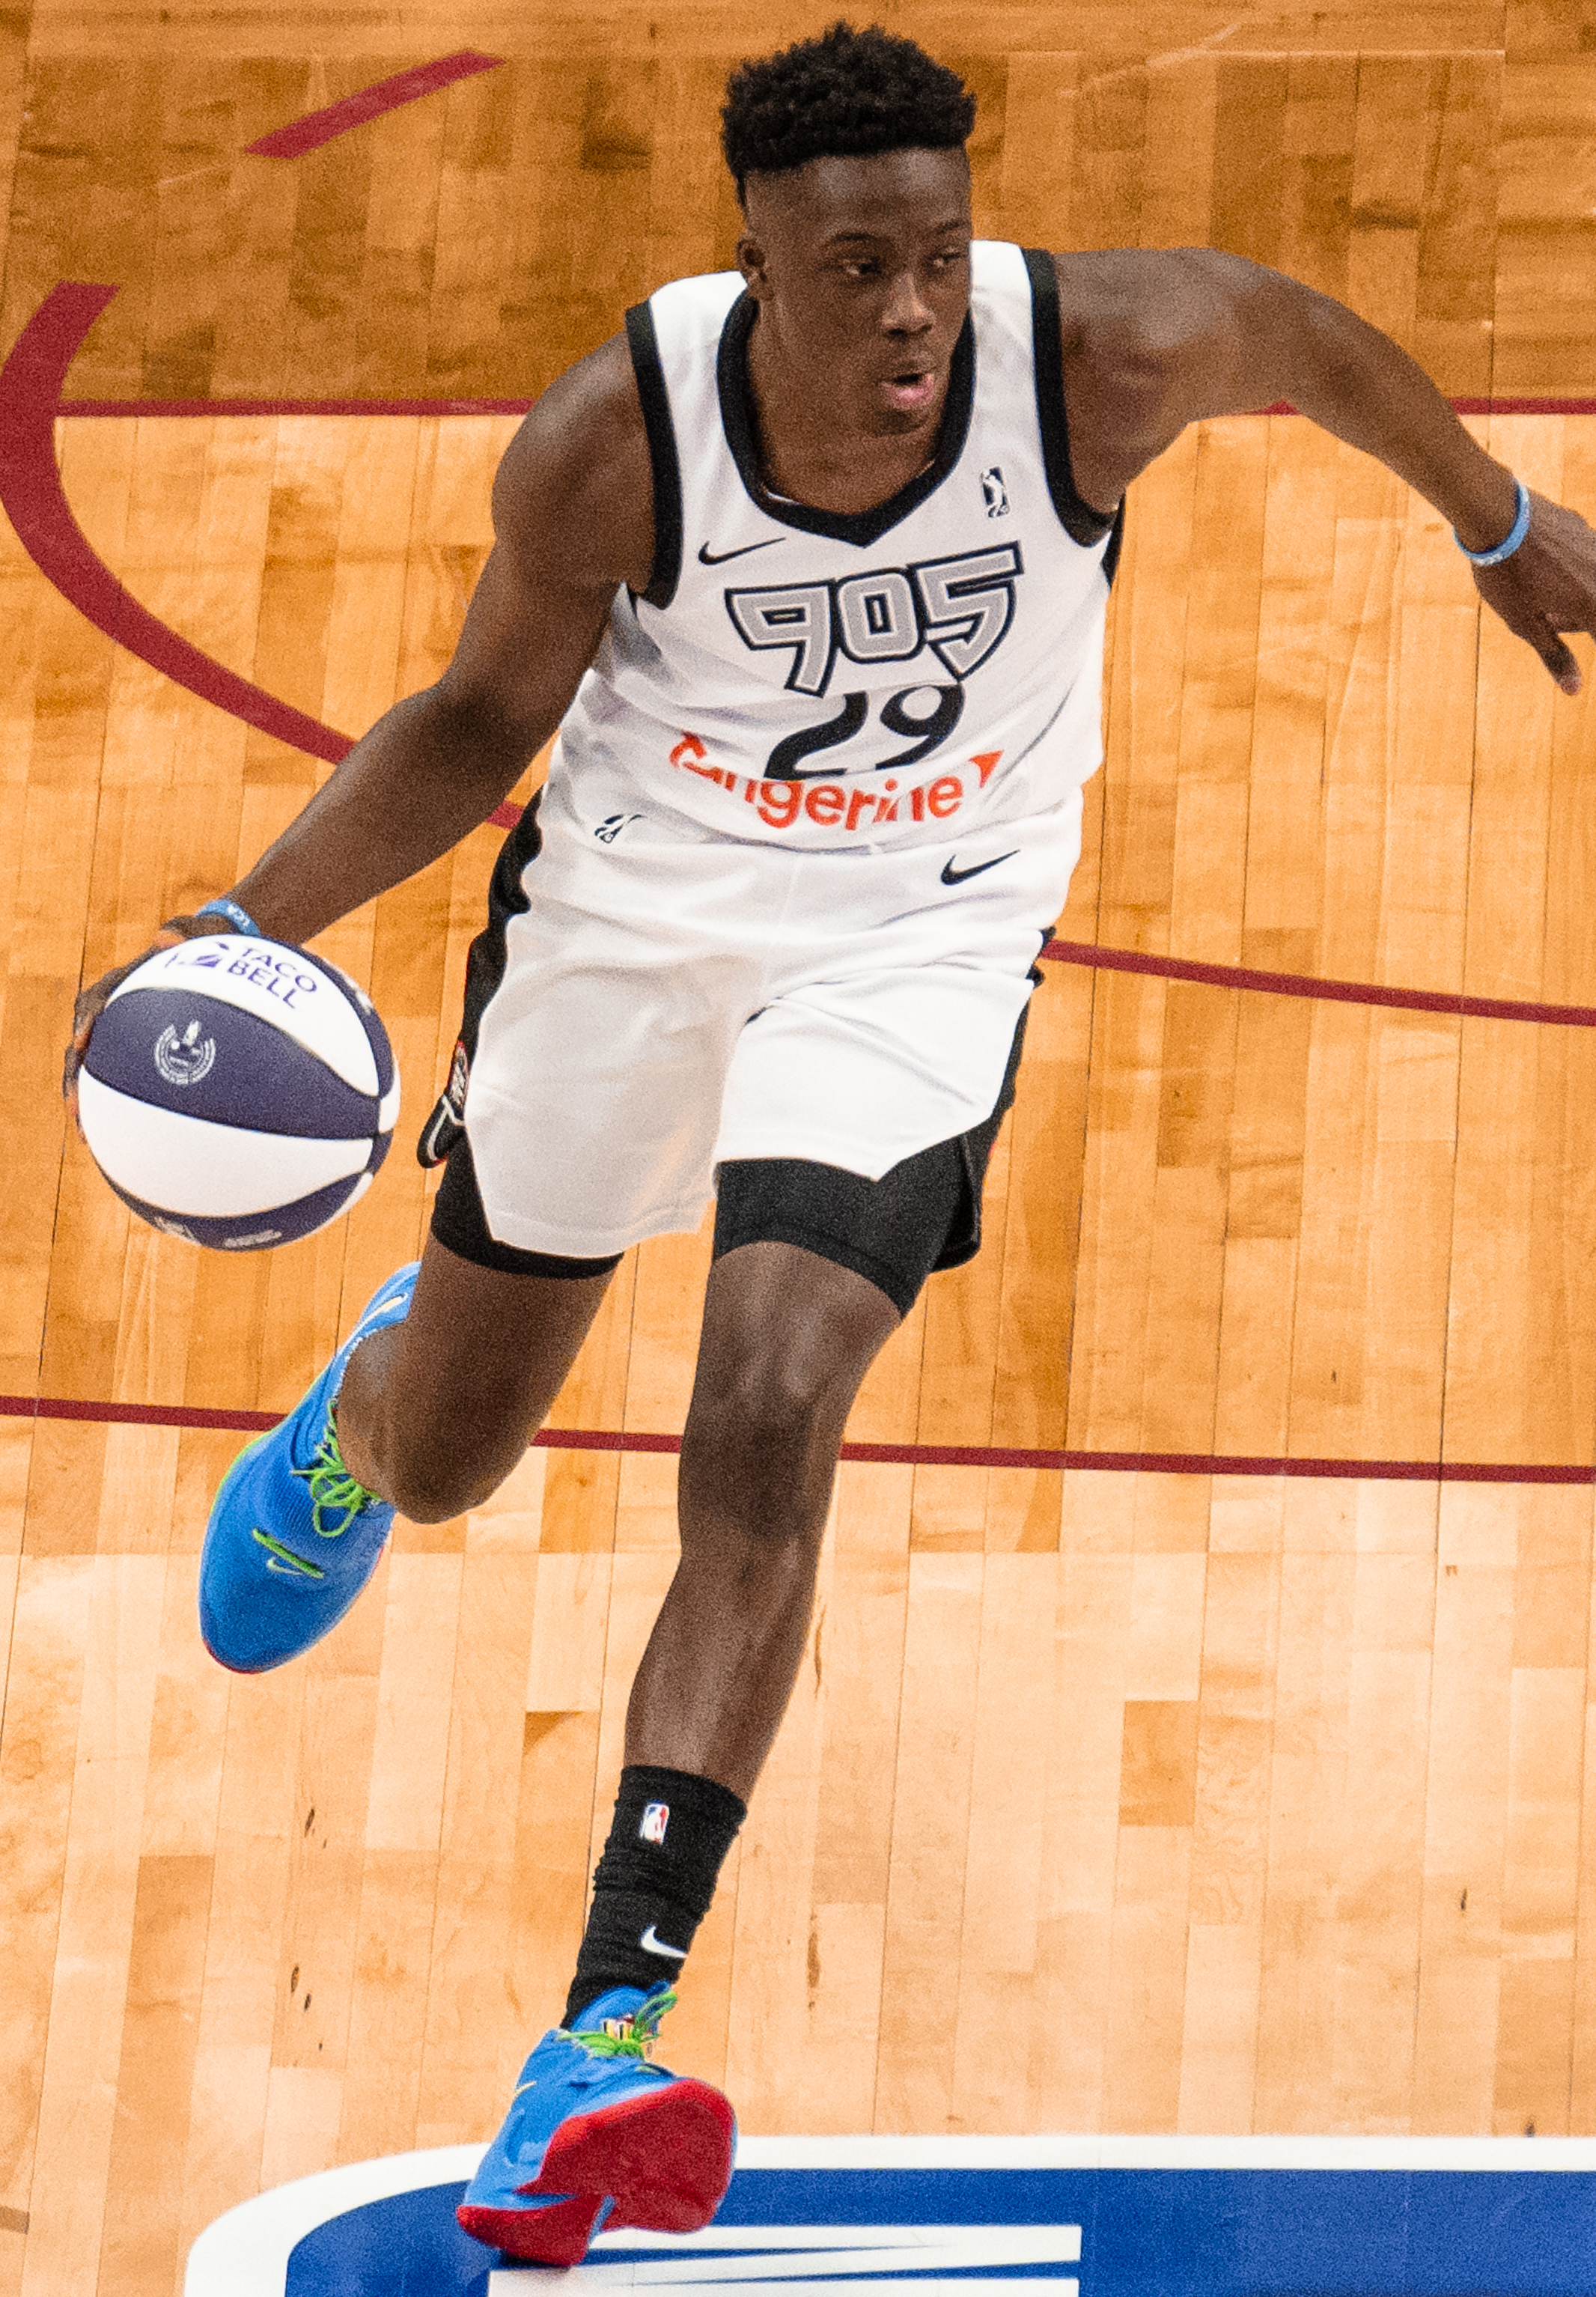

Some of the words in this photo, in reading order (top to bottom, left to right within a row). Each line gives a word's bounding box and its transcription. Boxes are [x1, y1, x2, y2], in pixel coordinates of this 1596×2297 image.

[723, 541, 1025, 698] 905
[764, 684, 965, 780] 29
[227, 960, 296, 1009] BELL
[242, 946, 317, 992] TACO
